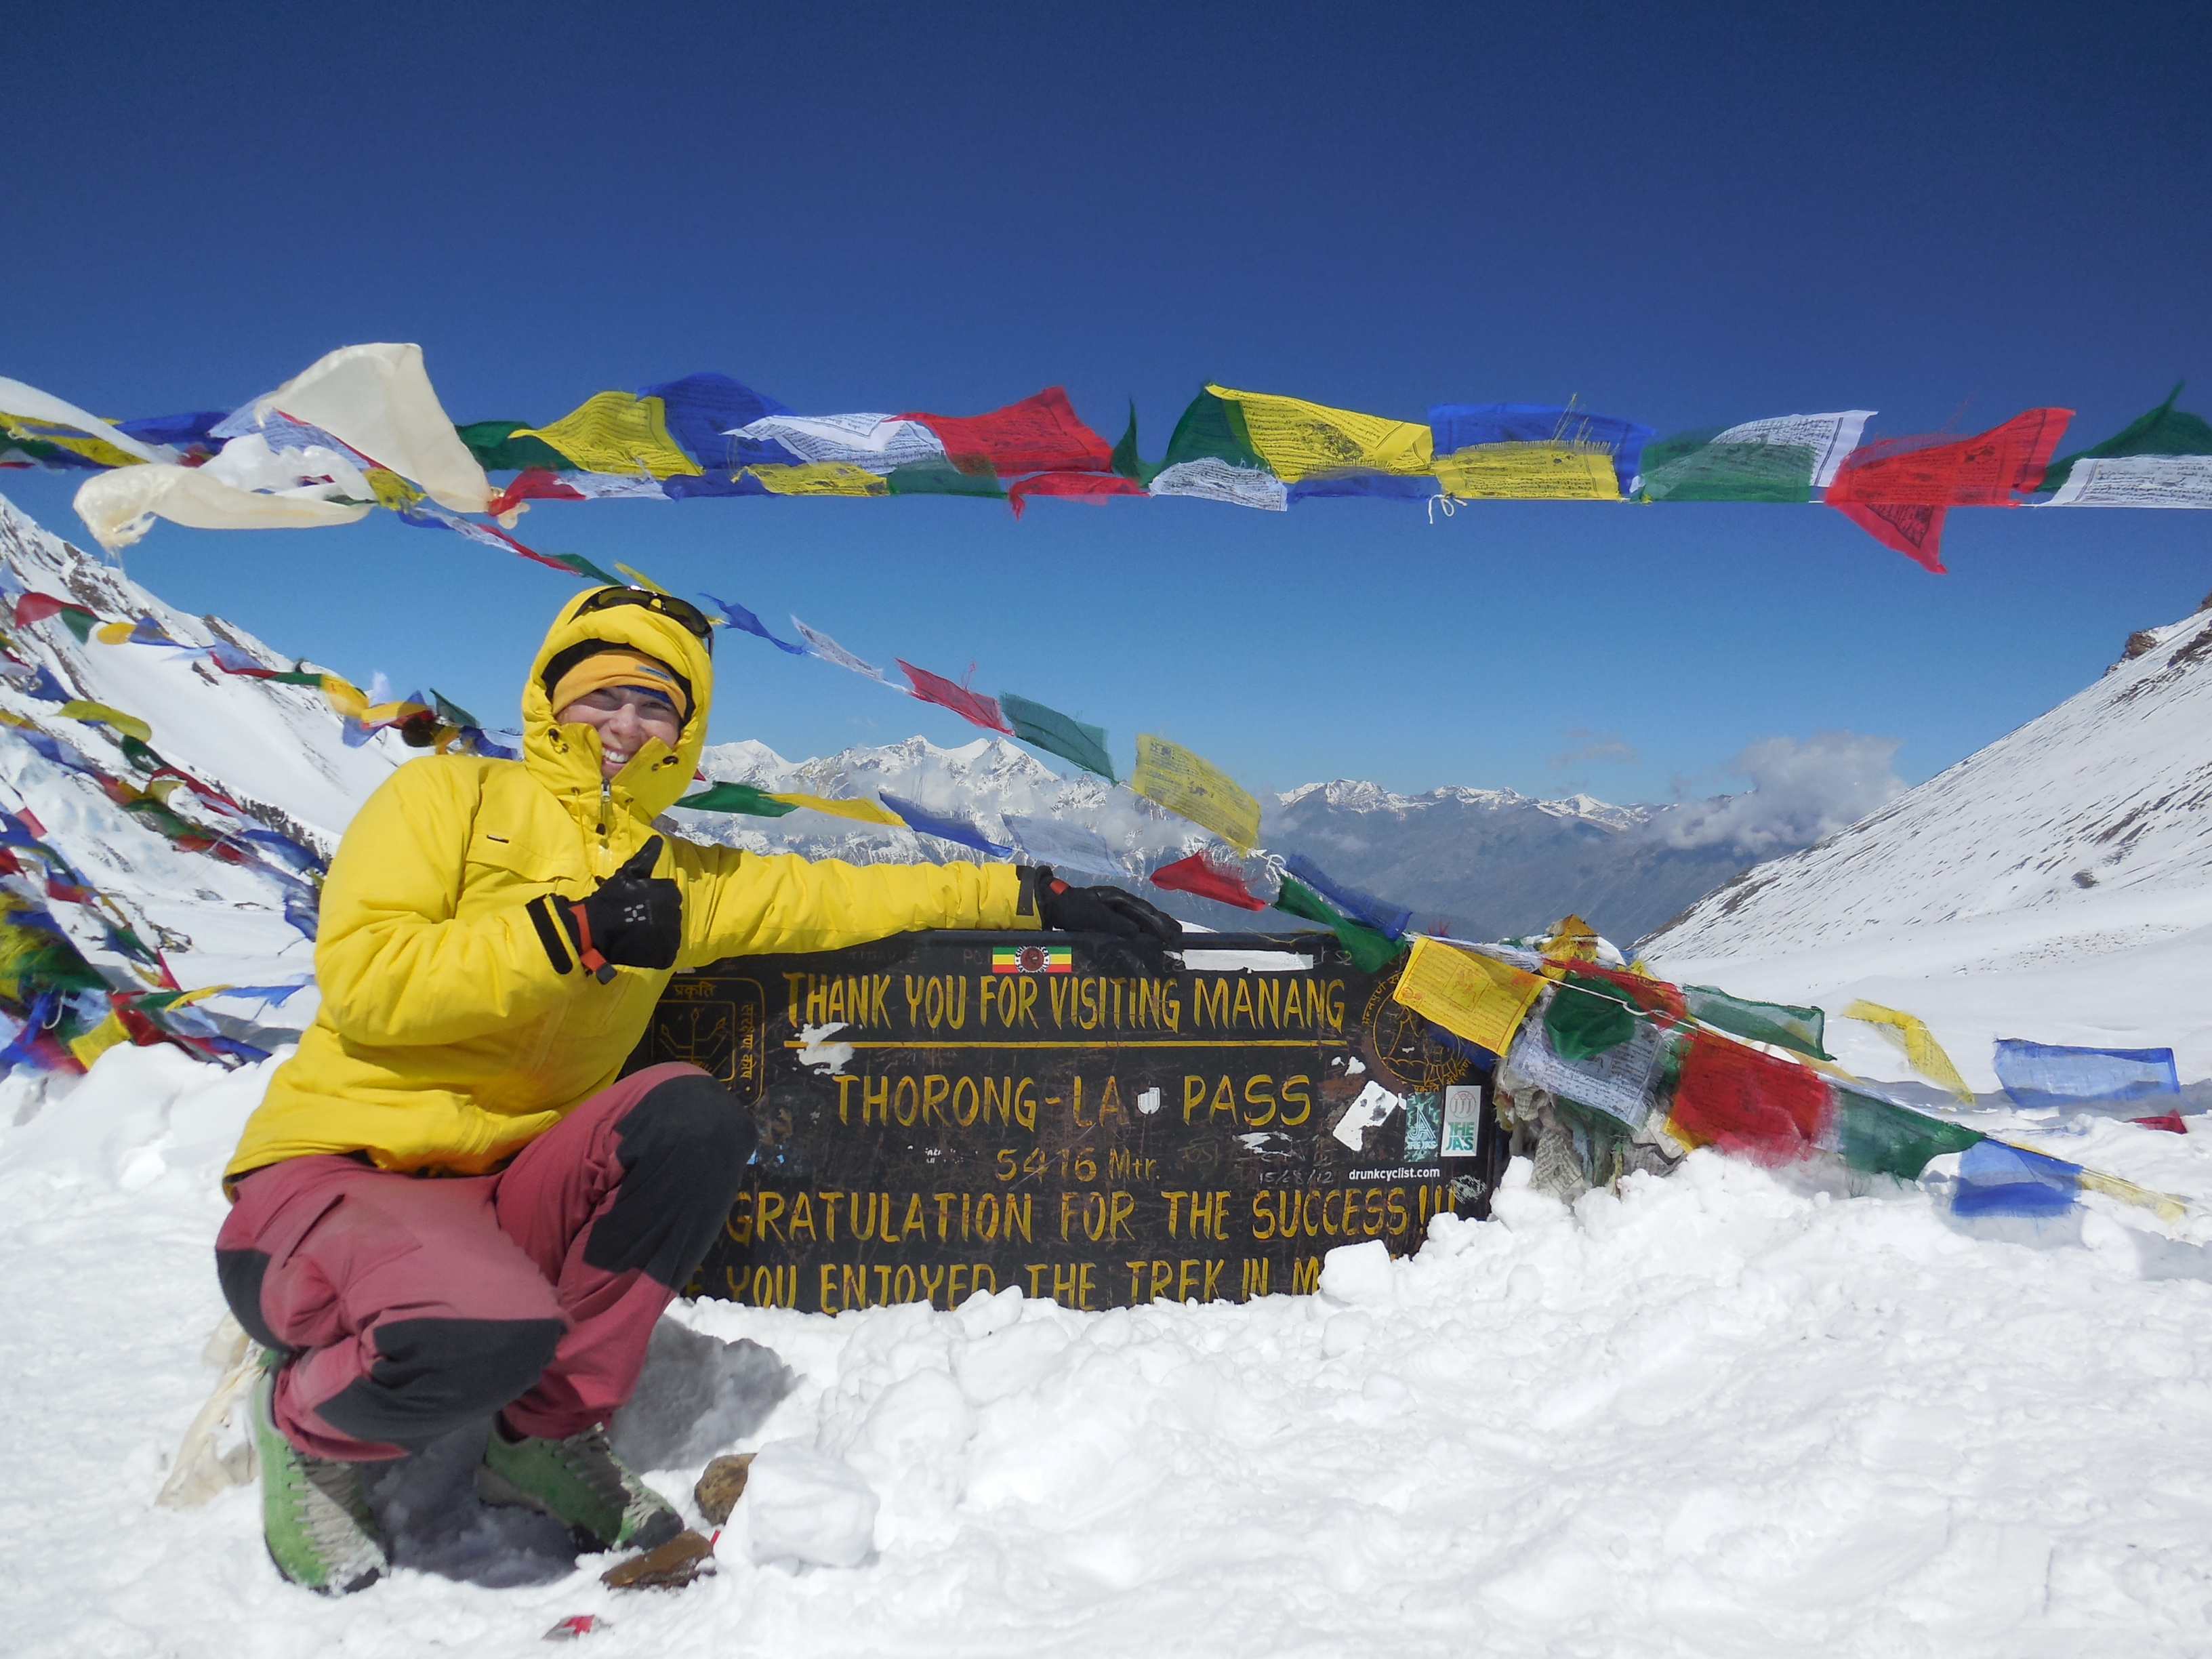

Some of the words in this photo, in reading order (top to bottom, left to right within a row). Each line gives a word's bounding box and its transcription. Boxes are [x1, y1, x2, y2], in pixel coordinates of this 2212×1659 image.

[783, 972, 891, 1029] THANK
[905, 974, 967, 1029] YOU
[980, 975, 1039, 1029] FOR
[1049, 976, 1181, 1033] VISITING
[1193, 977, 1345, 1033] MANANG
[1183, 1073, 1311, 1127] PASS
[1448, 1122, 1475, 1136] THE
[995, 1147, 1098, 1185] 5416
[1348, 1166, 1441, 1182] drunkcyclist.com
[725, 1191, 1032, 1247] GRATULATION
[1061, 1191, 1135, 1242] FOR
[1161, 1191, 1231, 1241] THE
[725, 1265, 797, 1309] YOU
[820, 1263, 997, 1315] ENJOYED
[1024, 1262, 1097, 1311] THE
[1125, 1258, 1225, 1305] TREK
[1241, 1256, 1269, 1303] IN
